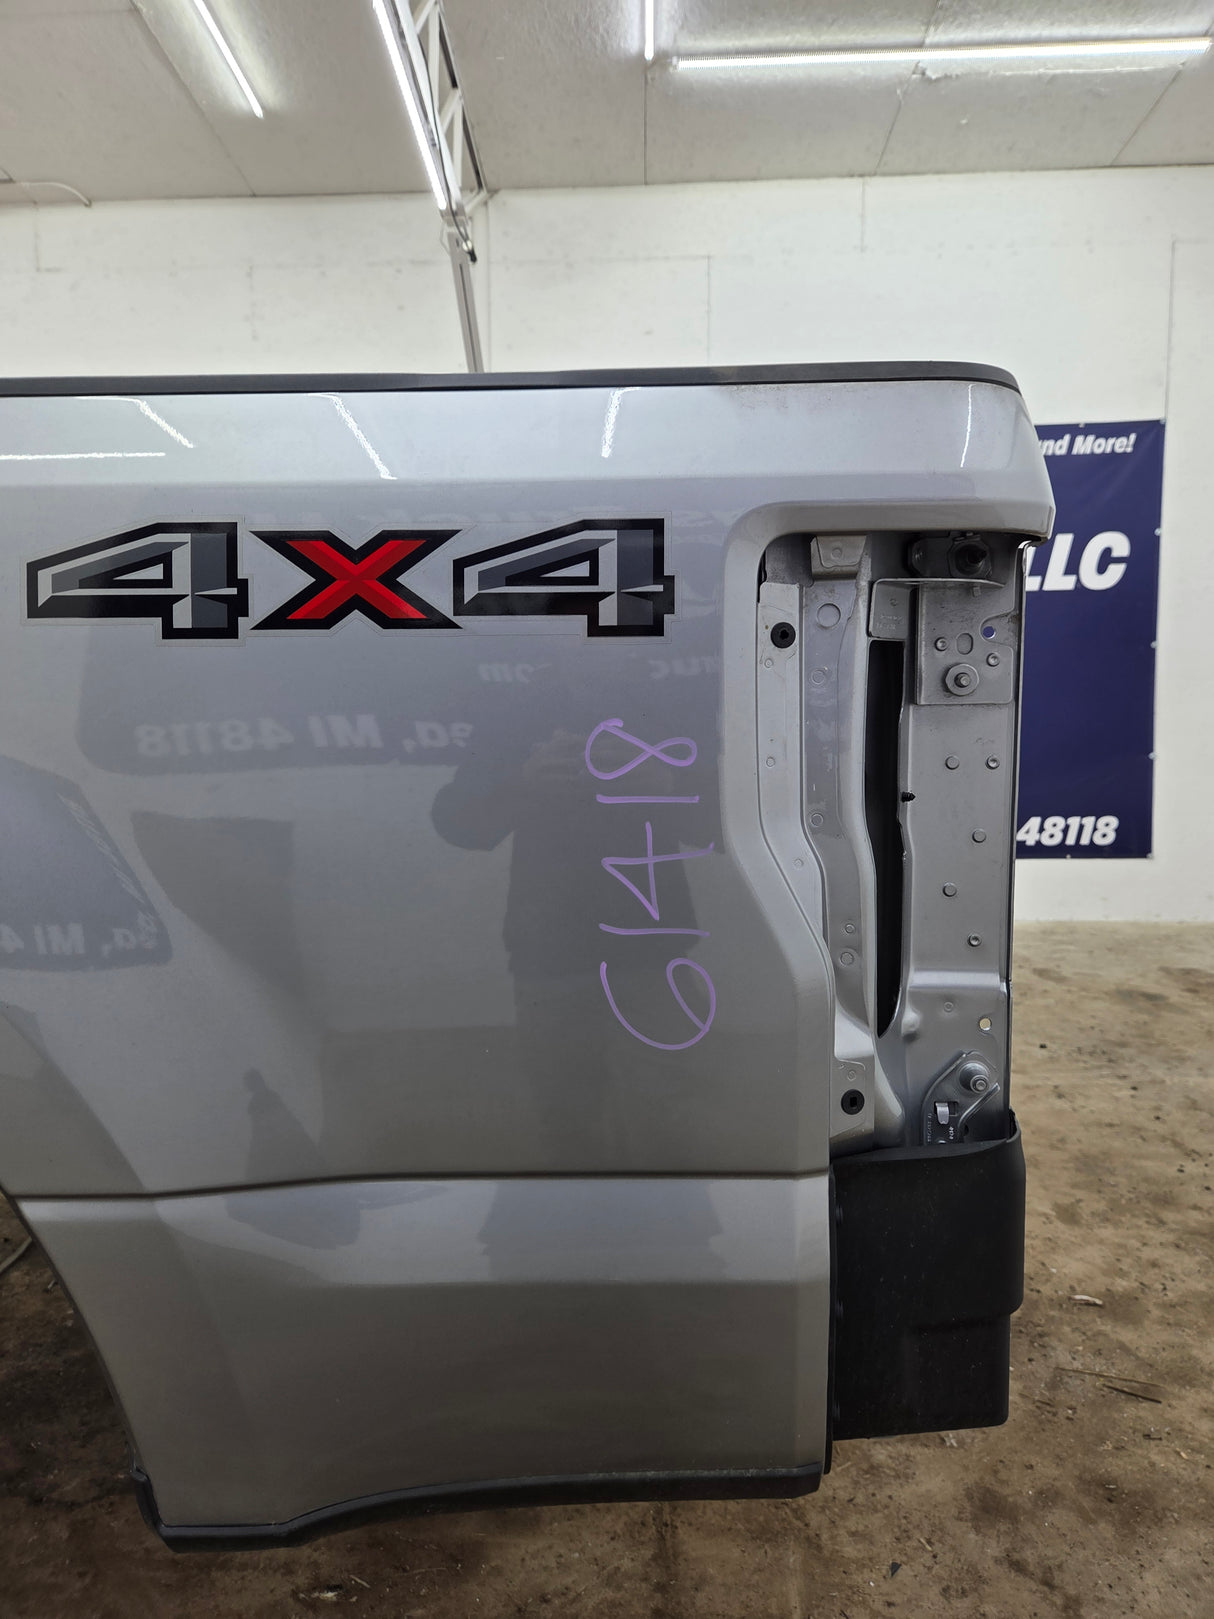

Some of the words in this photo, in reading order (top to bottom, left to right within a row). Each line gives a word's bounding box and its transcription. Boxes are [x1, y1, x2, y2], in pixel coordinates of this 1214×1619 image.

[1038, 433, 1071, 456] nd
[1071, 433, 1137, 455] More!
[1016, 815, 1120, 847] 48118
